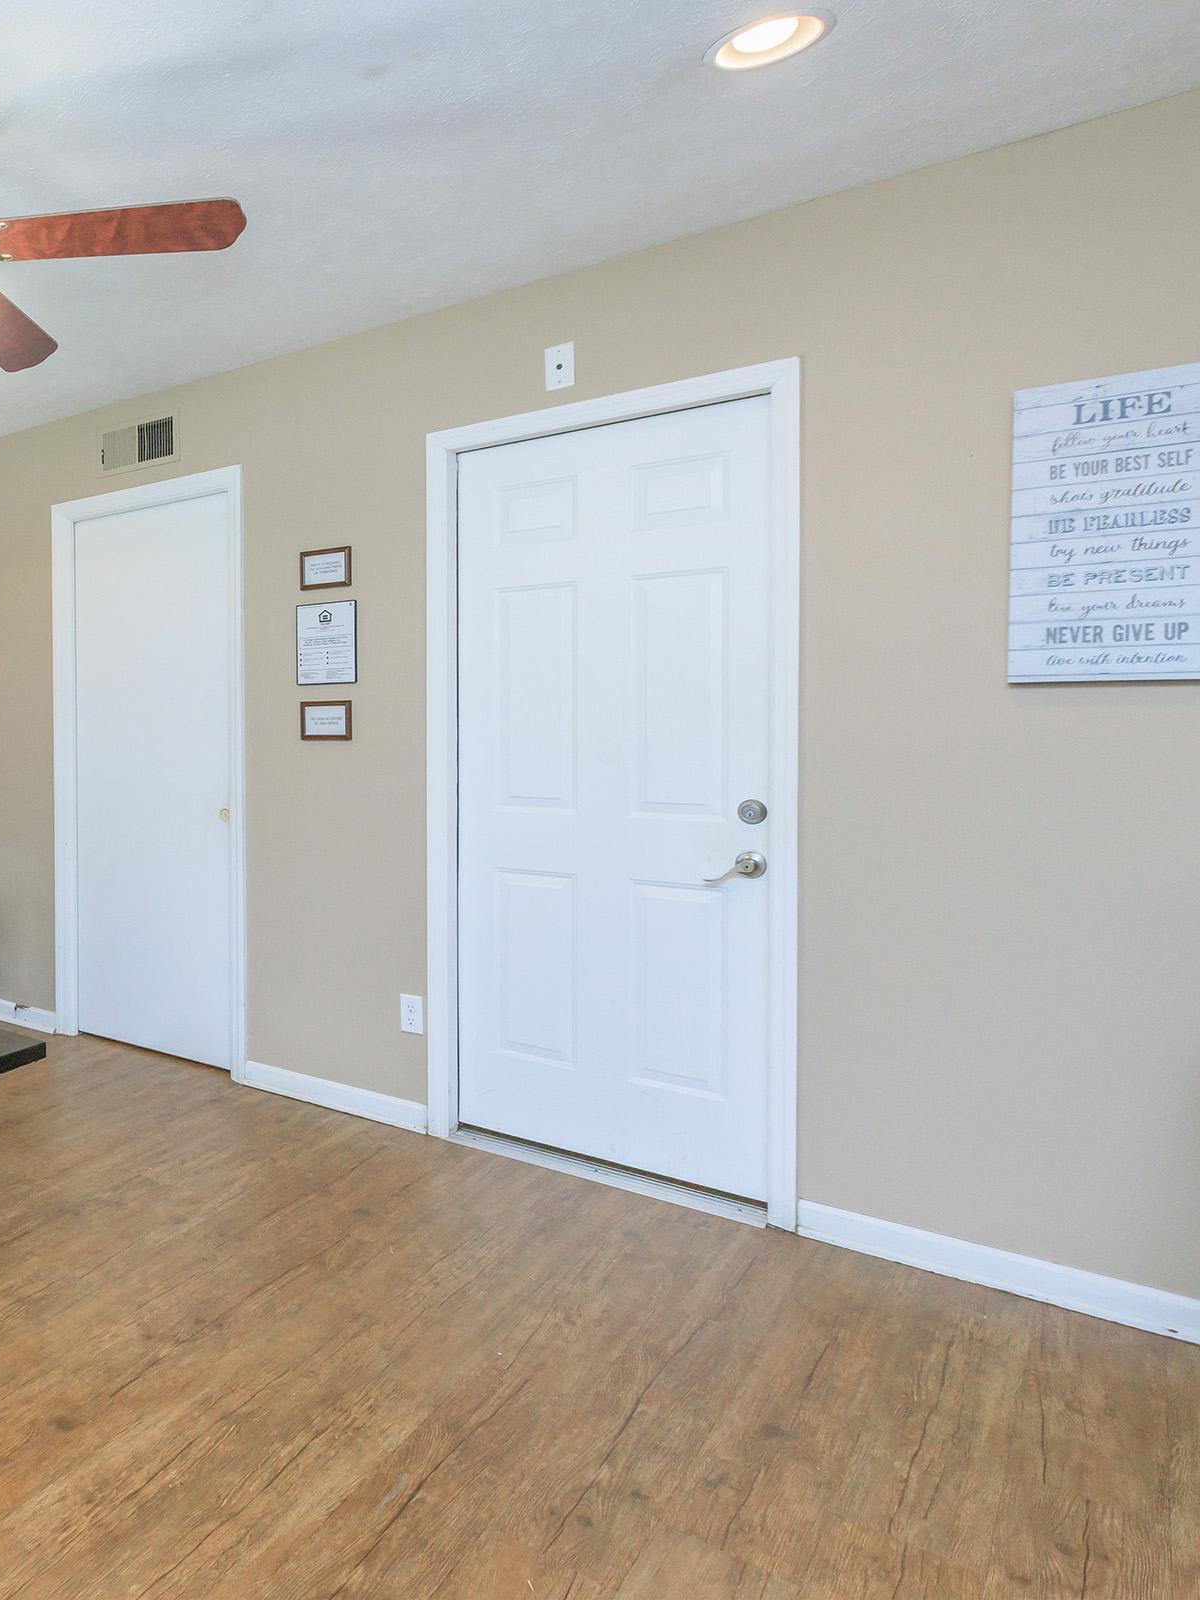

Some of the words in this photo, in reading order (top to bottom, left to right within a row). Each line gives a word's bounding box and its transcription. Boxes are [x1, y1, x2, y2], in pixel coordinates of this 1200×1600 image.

[1071, 391, 1172, 426] LIFE
[1051, 431, 1095, 456] follow
[1102, 430, 1141, 451] your
[1146, 420, 1190, 439] heart
[1049, 464, 1067, 480] BE
[1073, 459, 1108, 478] YOUR
[1115, 454, 1151, 473] BEST
[1157, 448, 1194, 468] SELF
[1049, 489, 1093, 505] show
[1099, 478, 1193, 505] gratitude
[1083, 507, 1191, 532] FEARLESS
[1050, 543, 1077, 564] try
[1084, 544, 1122, 556] new
[1131, 536, 1192, 557] things
[1047, 572, 1075, 588] BE
[1083, 565, 1191, 586] PRESENT
[1080, 600, 1119, 621] your
[1126, 593, 1186, 610] dreams
[1046, 625, 1103, 644] NEVER
[1112, 622, 1155, 642] GIVE
[1163, 621, 1190, 641] UP
[1046, 654, 1074, 667] live
[1079, 653, 1113, 666] with
[1116, 652, 1187, 665] intention
